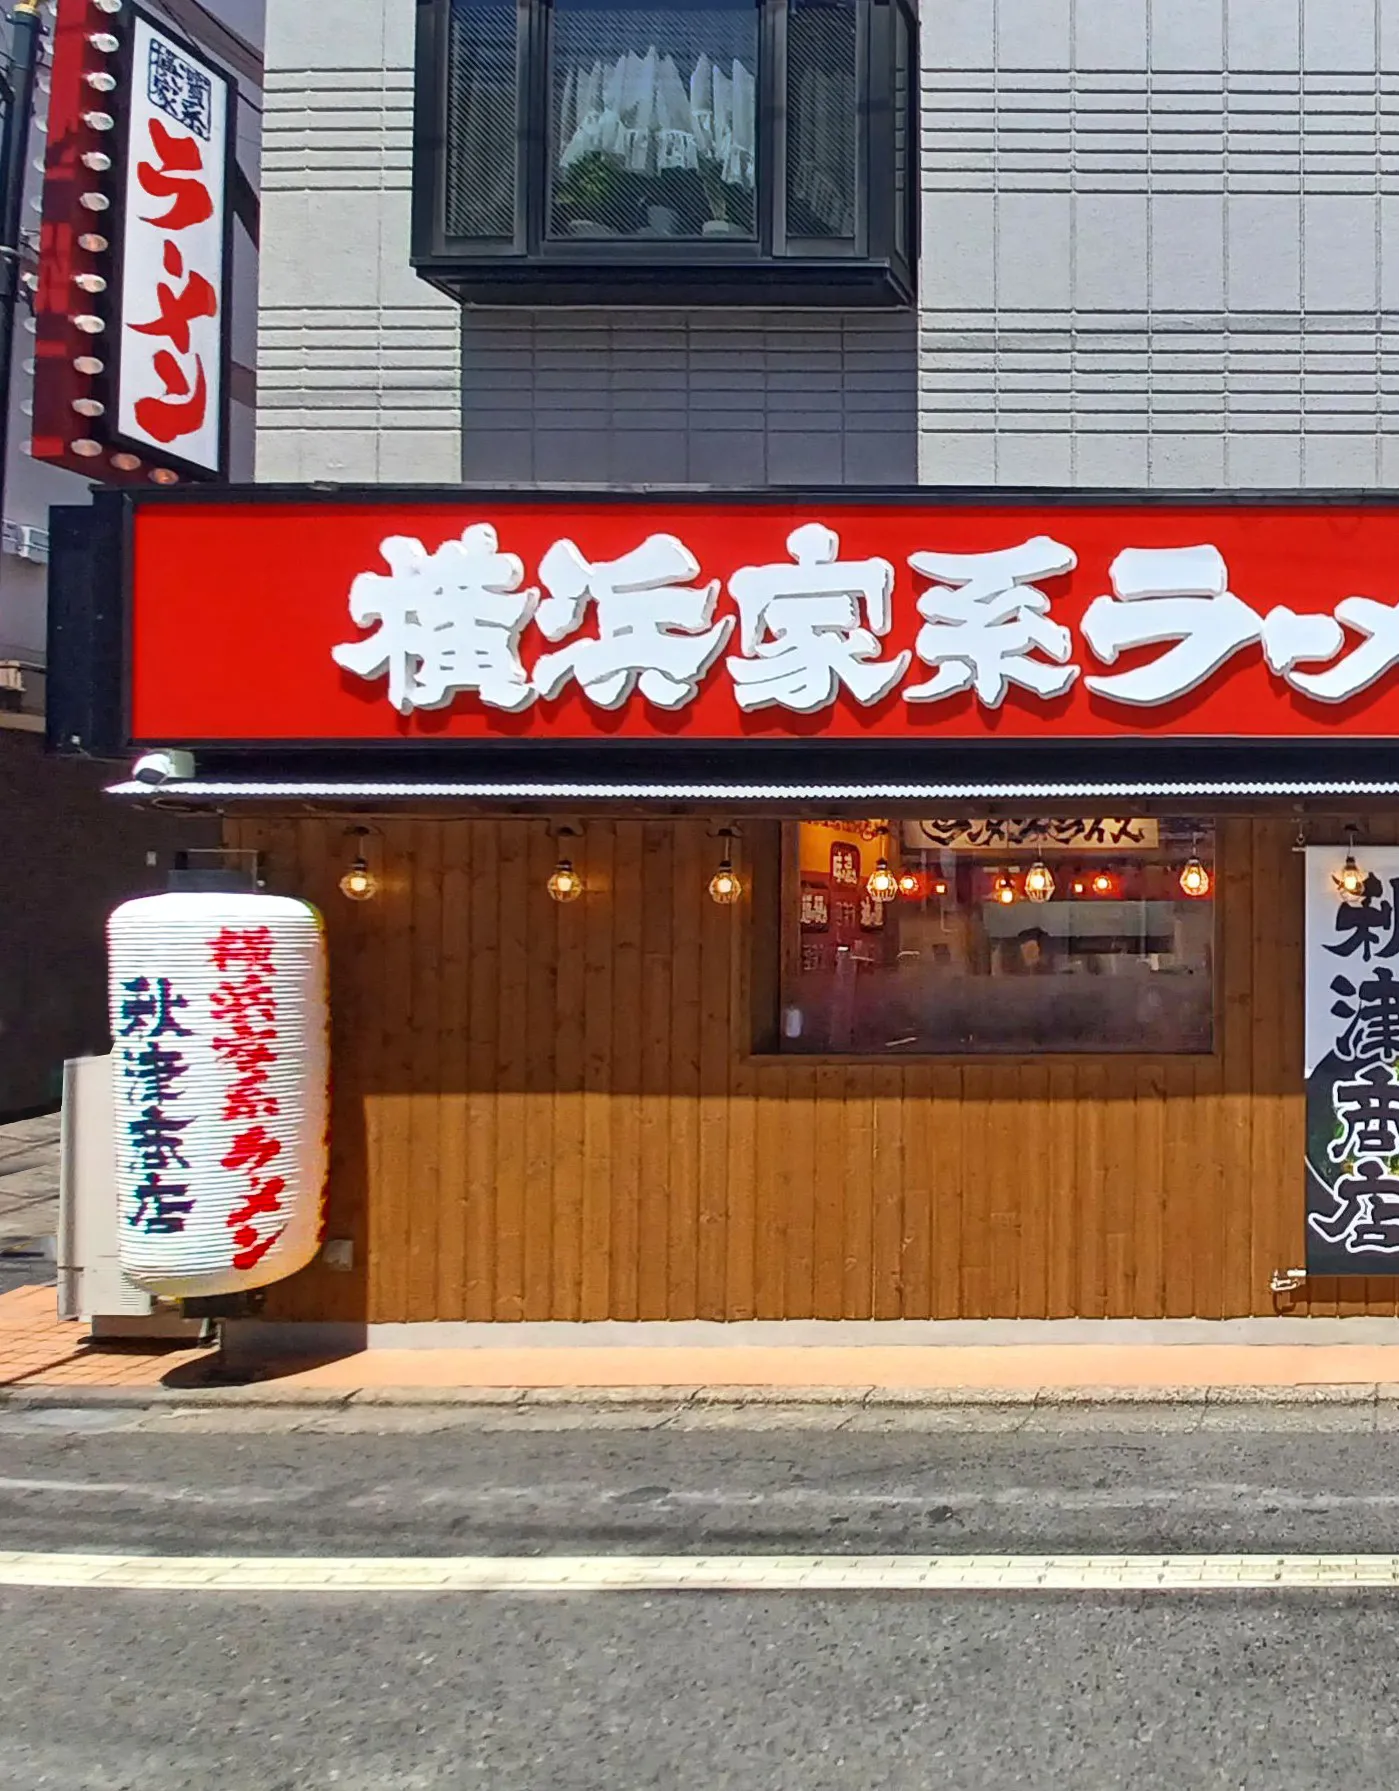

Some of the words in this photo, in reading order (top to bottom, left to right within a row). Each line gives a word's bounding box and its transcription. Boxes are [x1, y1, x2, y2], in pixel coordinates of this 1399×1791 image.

[127, 118, 217, 444] ラーメン
[120, 975, 199, 1235] 秋津商店
